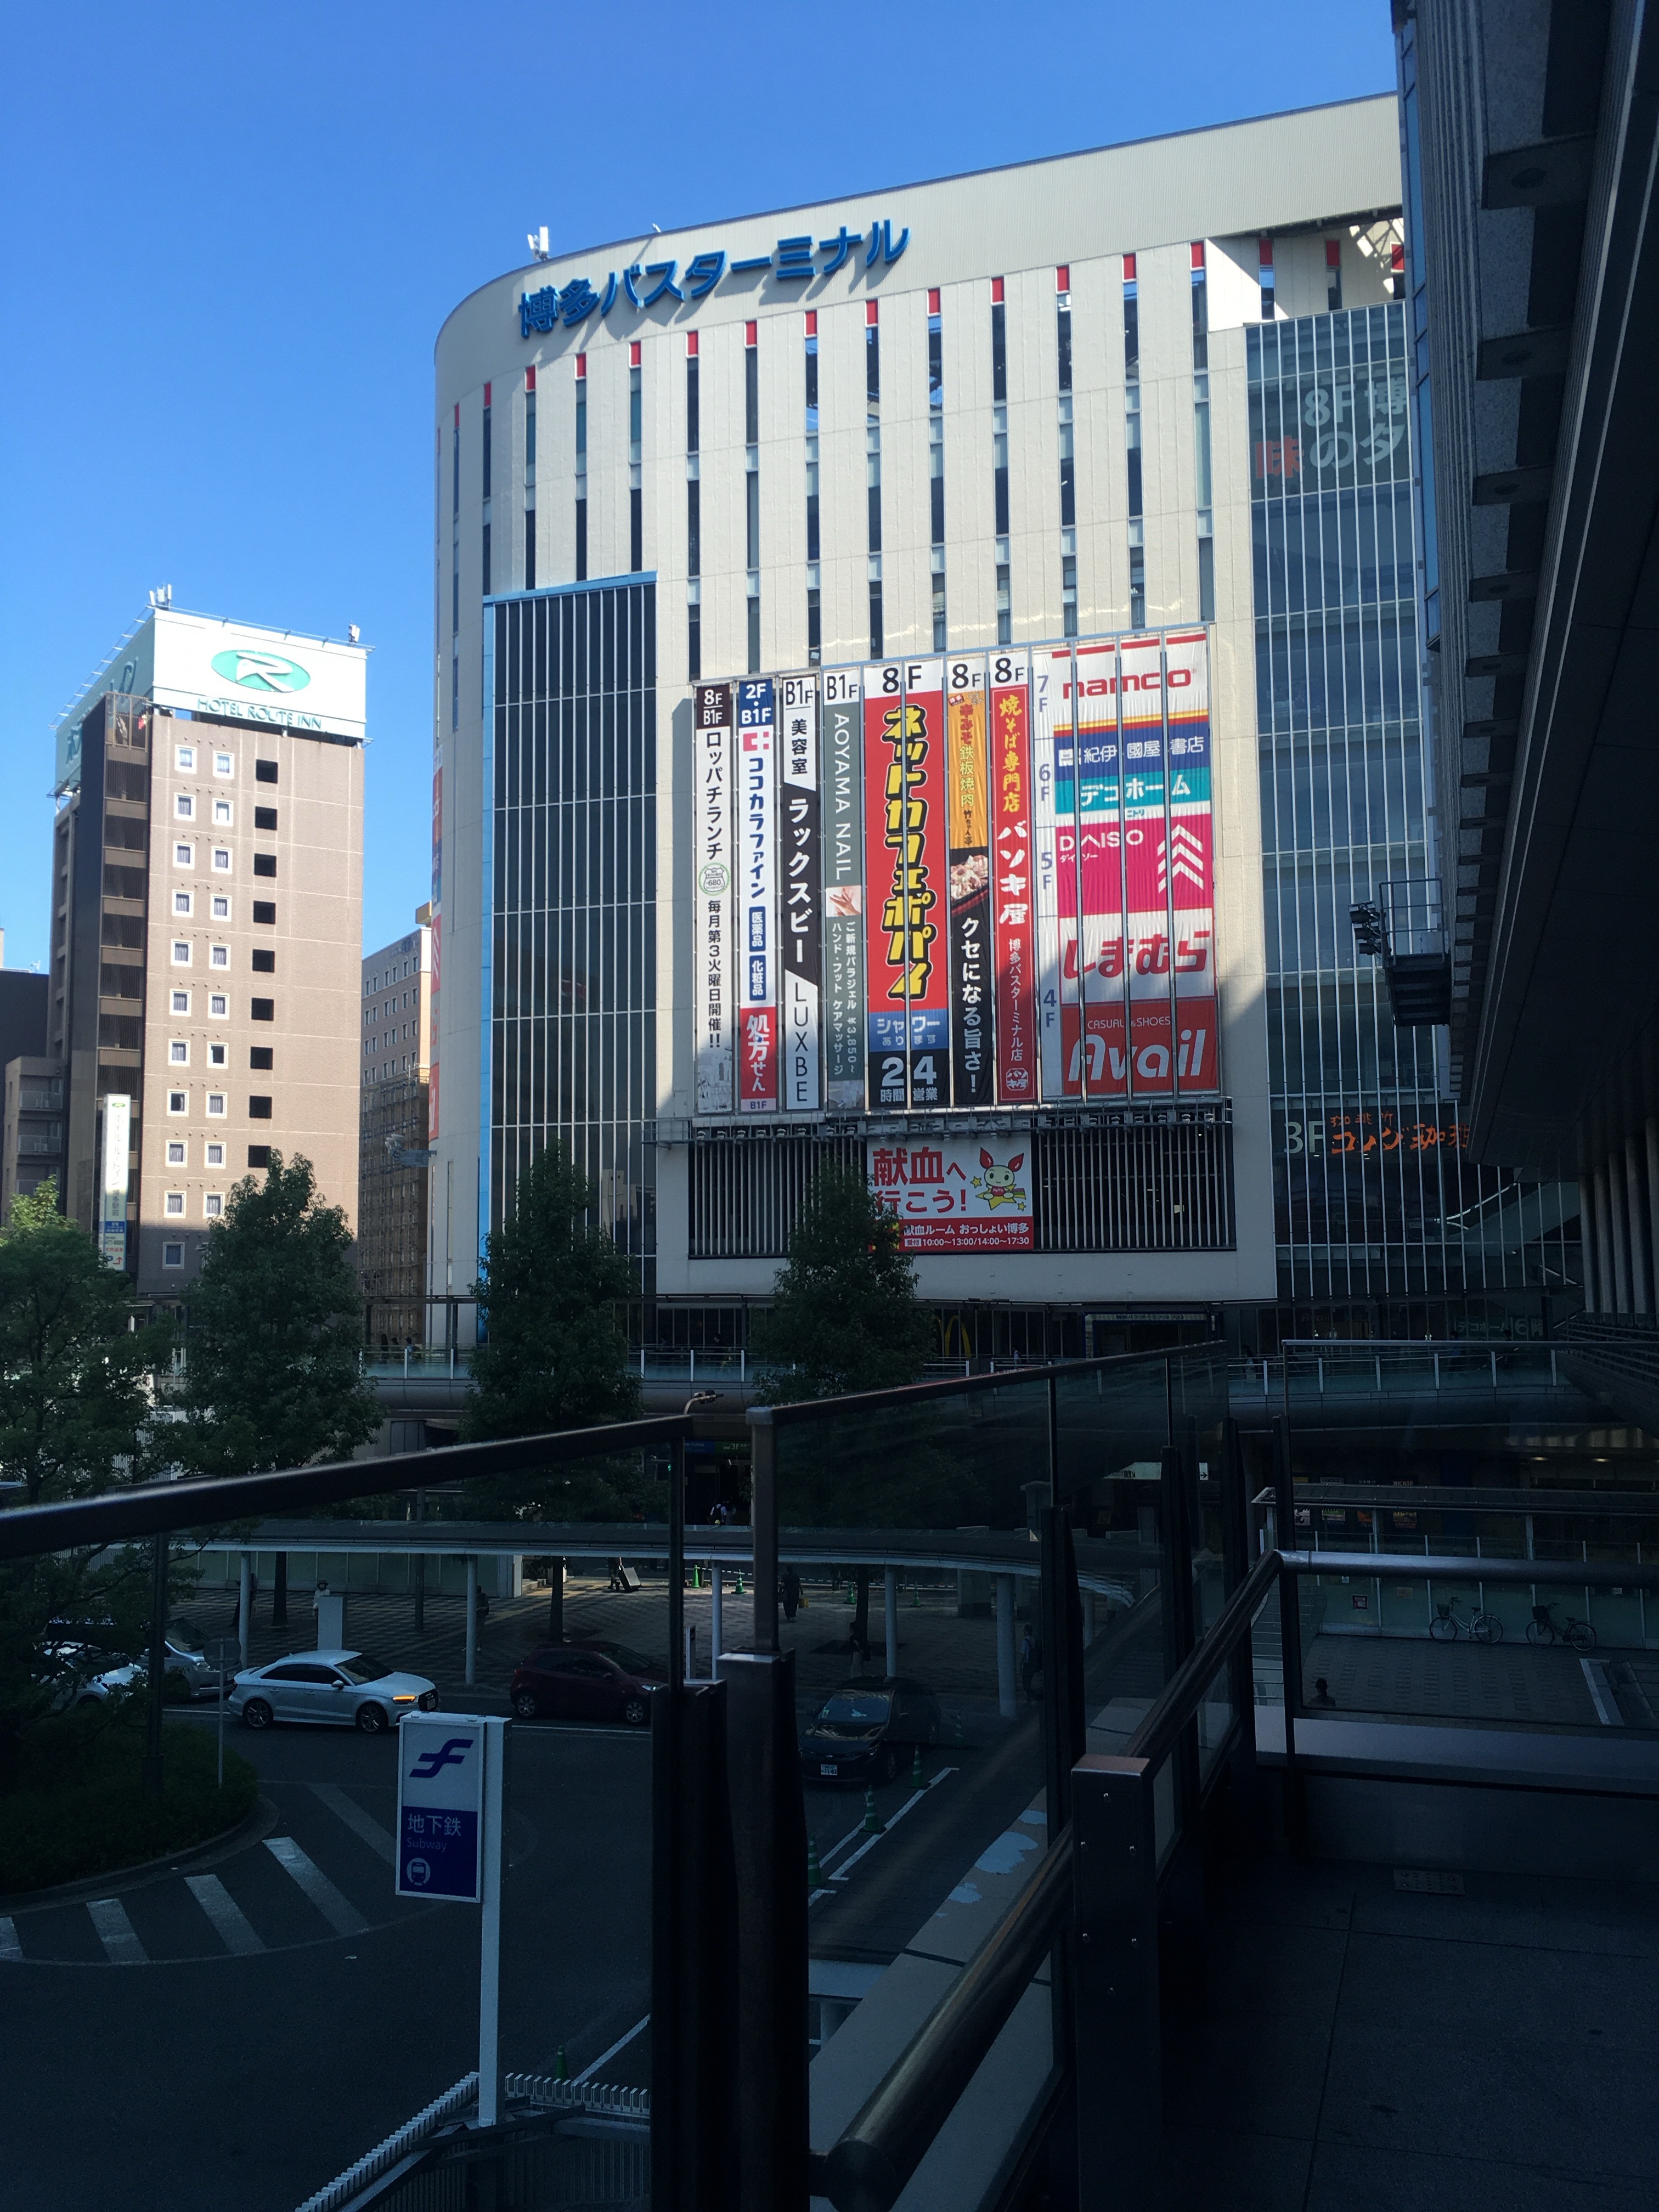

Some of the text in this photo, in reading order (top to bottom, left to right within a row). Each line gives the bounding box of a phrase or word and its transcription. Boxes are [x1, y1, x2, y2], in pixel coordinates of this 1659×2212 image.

[518, 219, 910, 338] 博多バスターミナル
[1305, 385, 1356, 426] 8F
[882, 664, 922, 693] 8F
[952, 663, 981, 689] 8F
[995, 658, 1024, 683] 8F
[1063, 669, 1191, 699] namco
[704, 689, 723, 706] 8F
[785, 681, 813, 706] B1F
[827, 675, 858, 700] B1F
[198, 698, 321, 730] HOTEL ROUTE INN
[703, 710, 723, 725] B1F
[741, 708, 771, 725] B1F
[792, 719, 808, 775] 美容室
[999, 695, 1022, 813] 焼そば専門店
[1084, 736, 1204, 764] 紀伊國屋書店
[706, 732, 723, 860] ロッパチランチ
[834, 713, 851, 880] AOYAMA NAIL
[1080, 774, 1190, 806] デコホーム
[749, 758, 765, 898] ココカラファイン
[1127, 809, 1145, 817] ニトリ
[1059, 829, 1144, 851] DAISO
[1060, 853, 1098, 863] ダイソー
[787, 798, 812, 963] ラックスビー
[751, 912, 763, 947] 医薬品
[1063, 931, 1210, 979] しまむら
[752, 960, 764, 996] 化粧品
[1008, 938, 1023, 1061] 博多バスターミナル店
[833, 1000, 844, 1075] ケアマッサージ
[877, 1015, 940, 1034] シャワー
[1087, 1019, 1124, 1029] CASUAL
[747, 1015, 769, 1092] 処方せん
[794, 983, 809, 1102] LUXBE
[882, 1035, 936, 1047] あります
[1068, 1029, 1206, 1082] Avail
[881, 1056, 938, 1086] 24
[751, 1101, 766, 1109] B1F
[880, 1087, 938, 1103] 時間営業
[1284, 1121, 1325, 1154] 3F
[873, 1146, 967, 1186] 献血へ
[904, 1222, 1029, 1236] 献血ルーム おっしょい博多
[407, 1814, 462, 1836] 地下鉄
[407, 1837, 448, 1853] Subway
